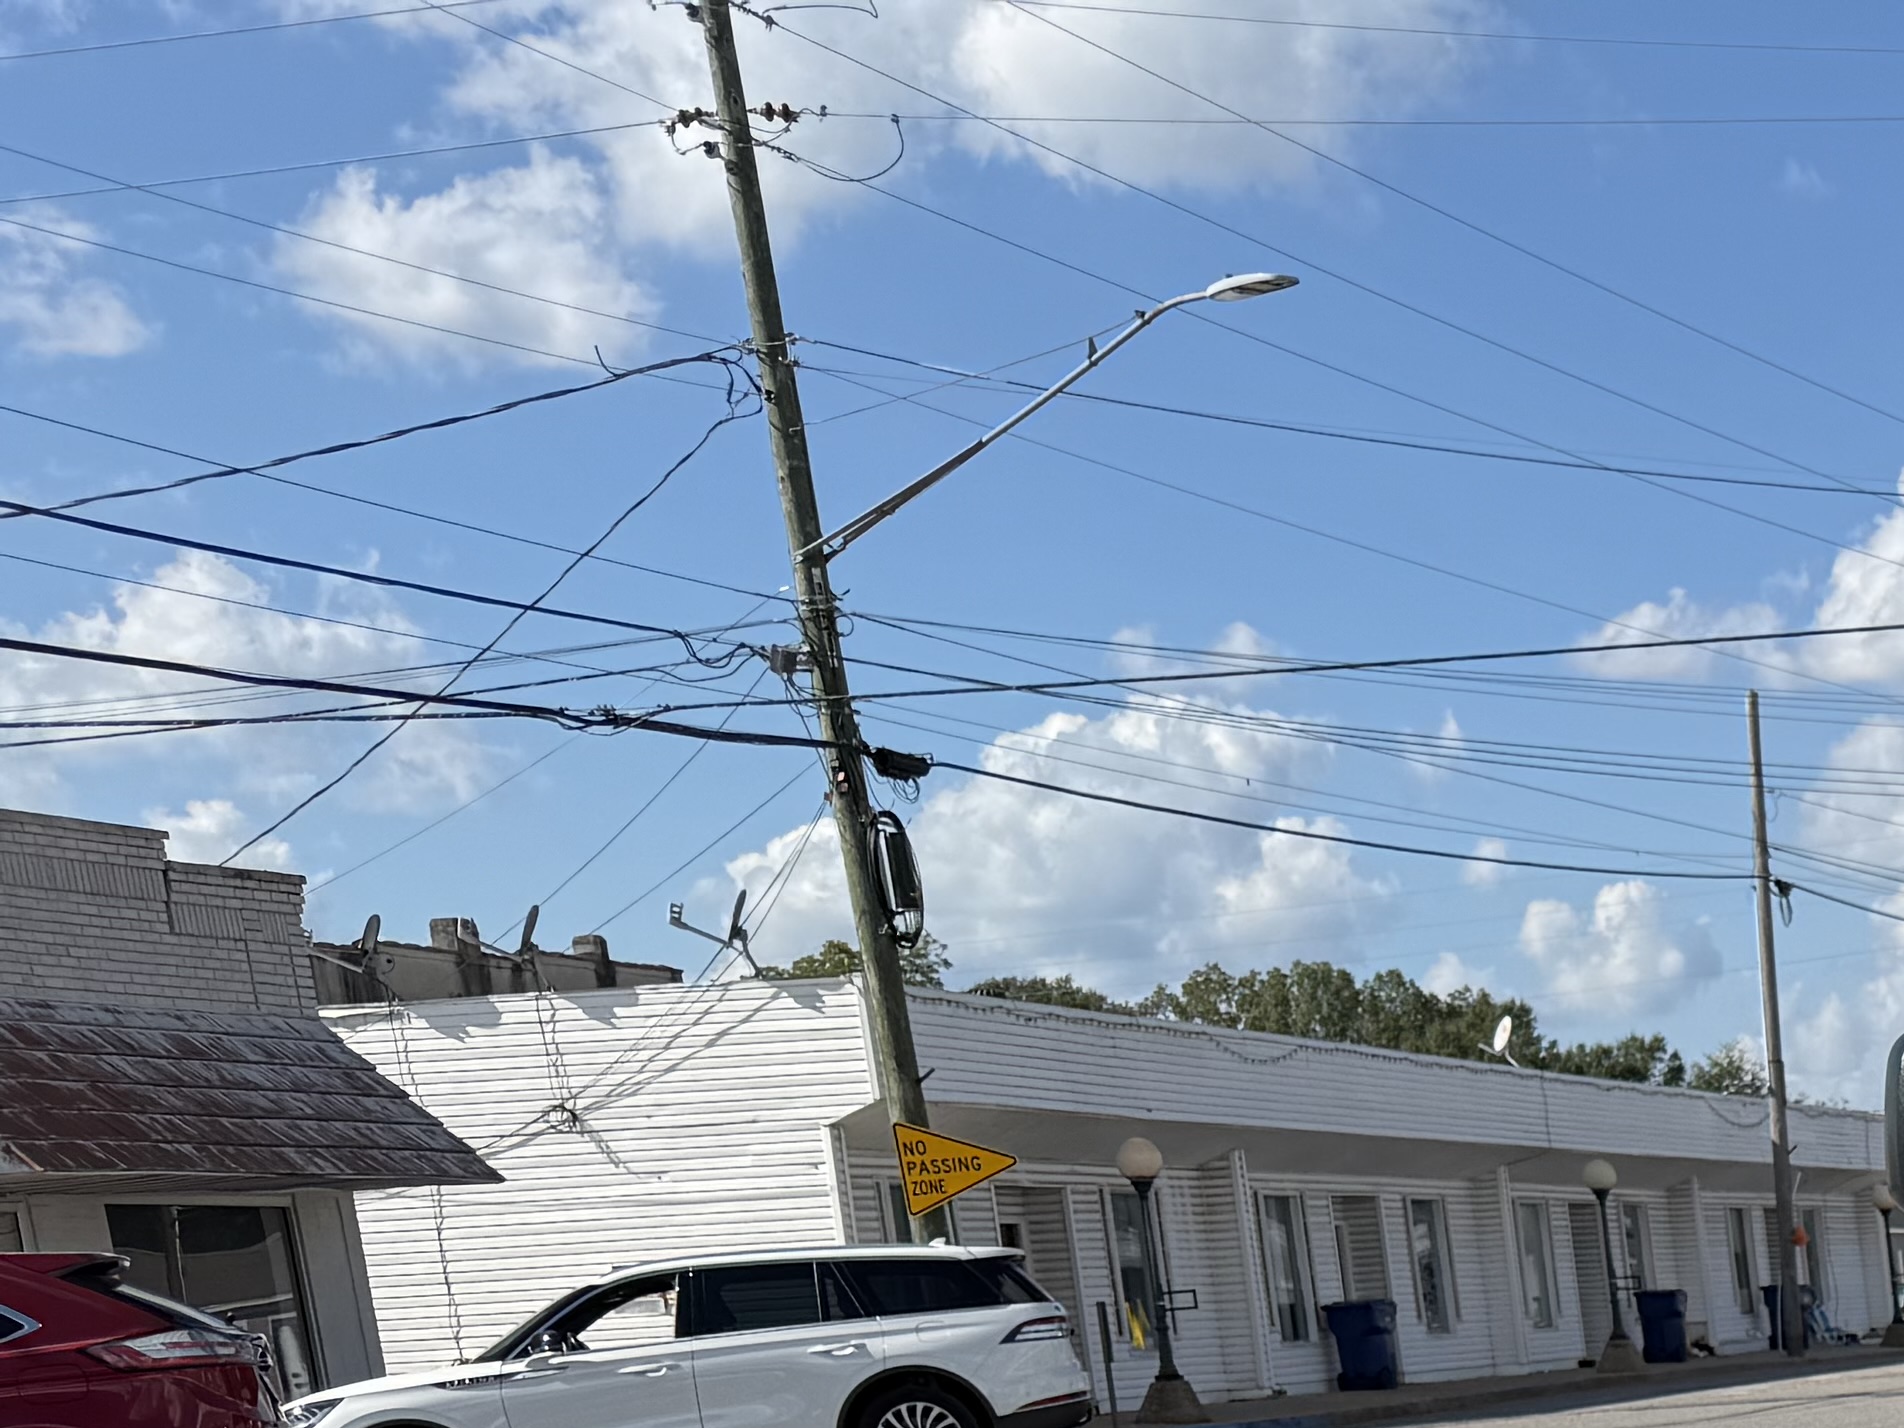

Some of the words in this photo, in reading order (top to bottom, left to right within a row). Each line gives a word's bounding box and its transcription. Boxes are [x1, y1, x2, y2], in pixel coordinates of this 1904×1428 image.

[902, 1140, 927, 1156] NO
[907, 1156, 982, 1176] PASSING
[911, 1179, 948, 1196] ZONE
